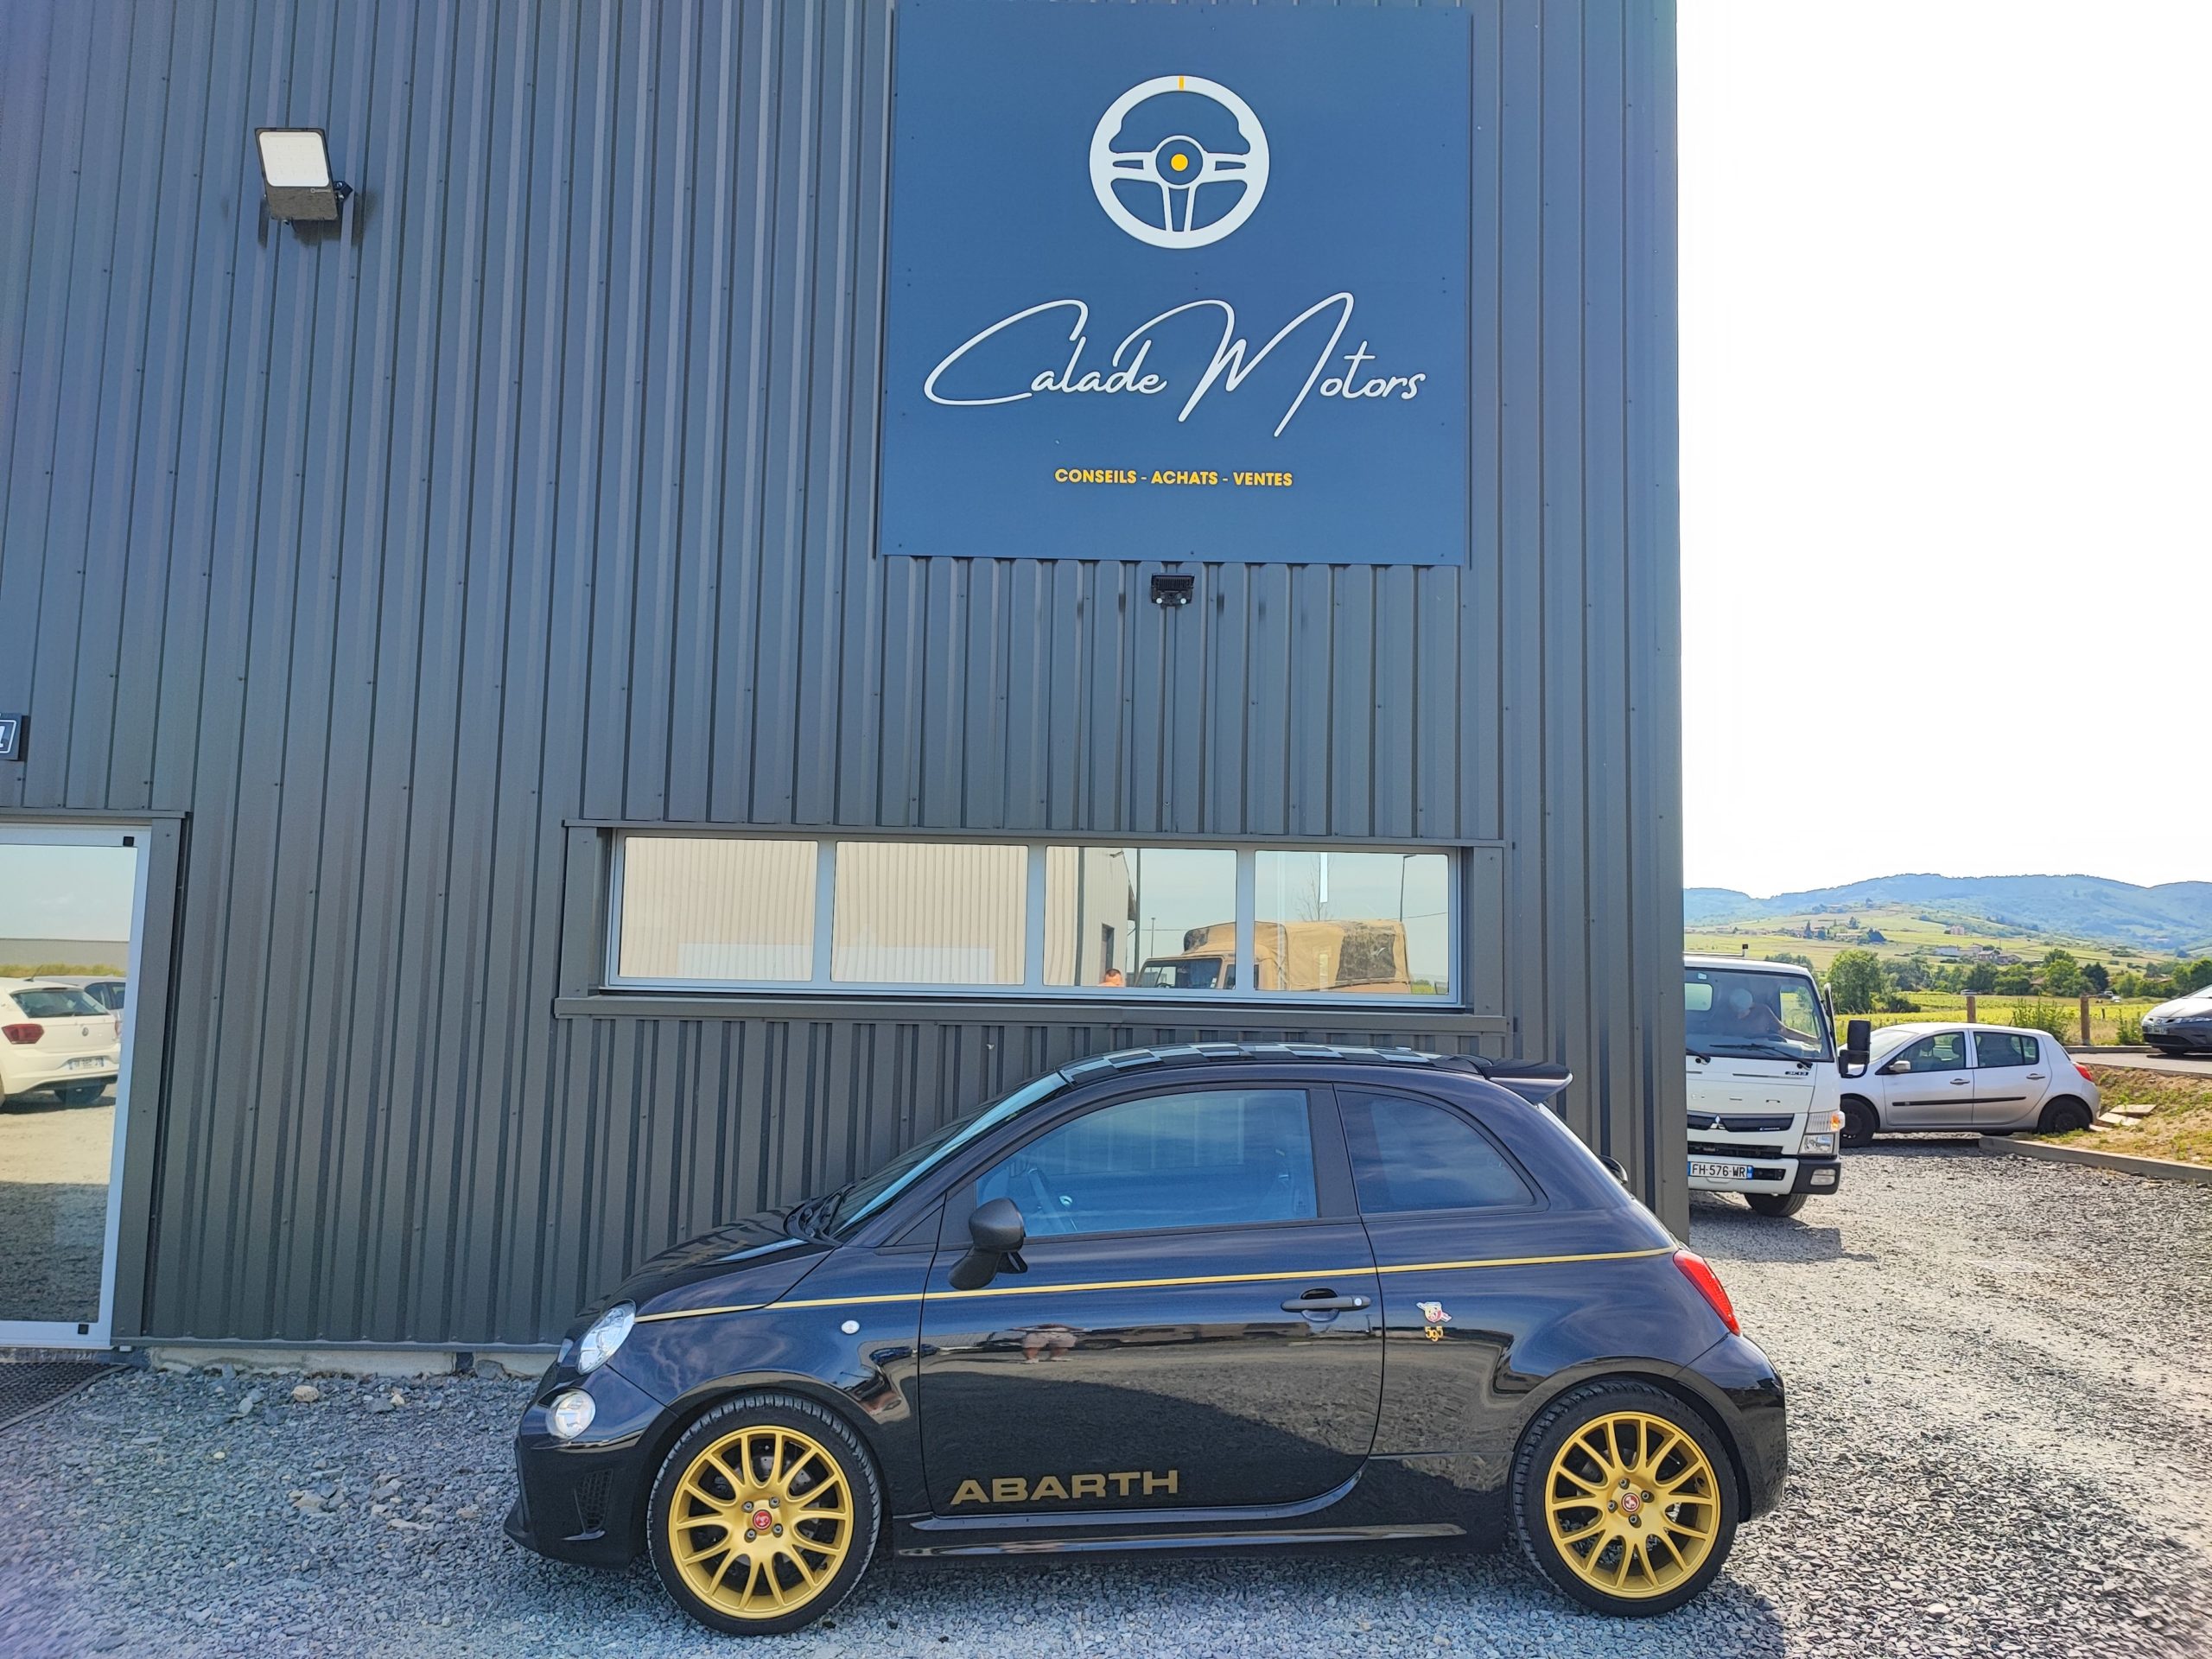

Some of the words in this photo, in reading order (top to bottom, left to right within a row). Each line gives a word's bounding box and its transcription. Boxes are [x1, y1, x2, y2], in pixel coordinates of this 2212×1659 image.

[924, 299, 1167, 405] Calade
[1113, 291, 1427, 438] Motors
[1054, 468, 1137, 484] CONSEILS
[1151, 470, 1218, 485] ACHATS
[1233, 472, 1293, 486] VENTES
[1692, 1163, 1745, 1178] FH-576-WR
[1425, 1325, 1444, 1342] 595
[950, 1470, 1178, 1504] ABARTH
